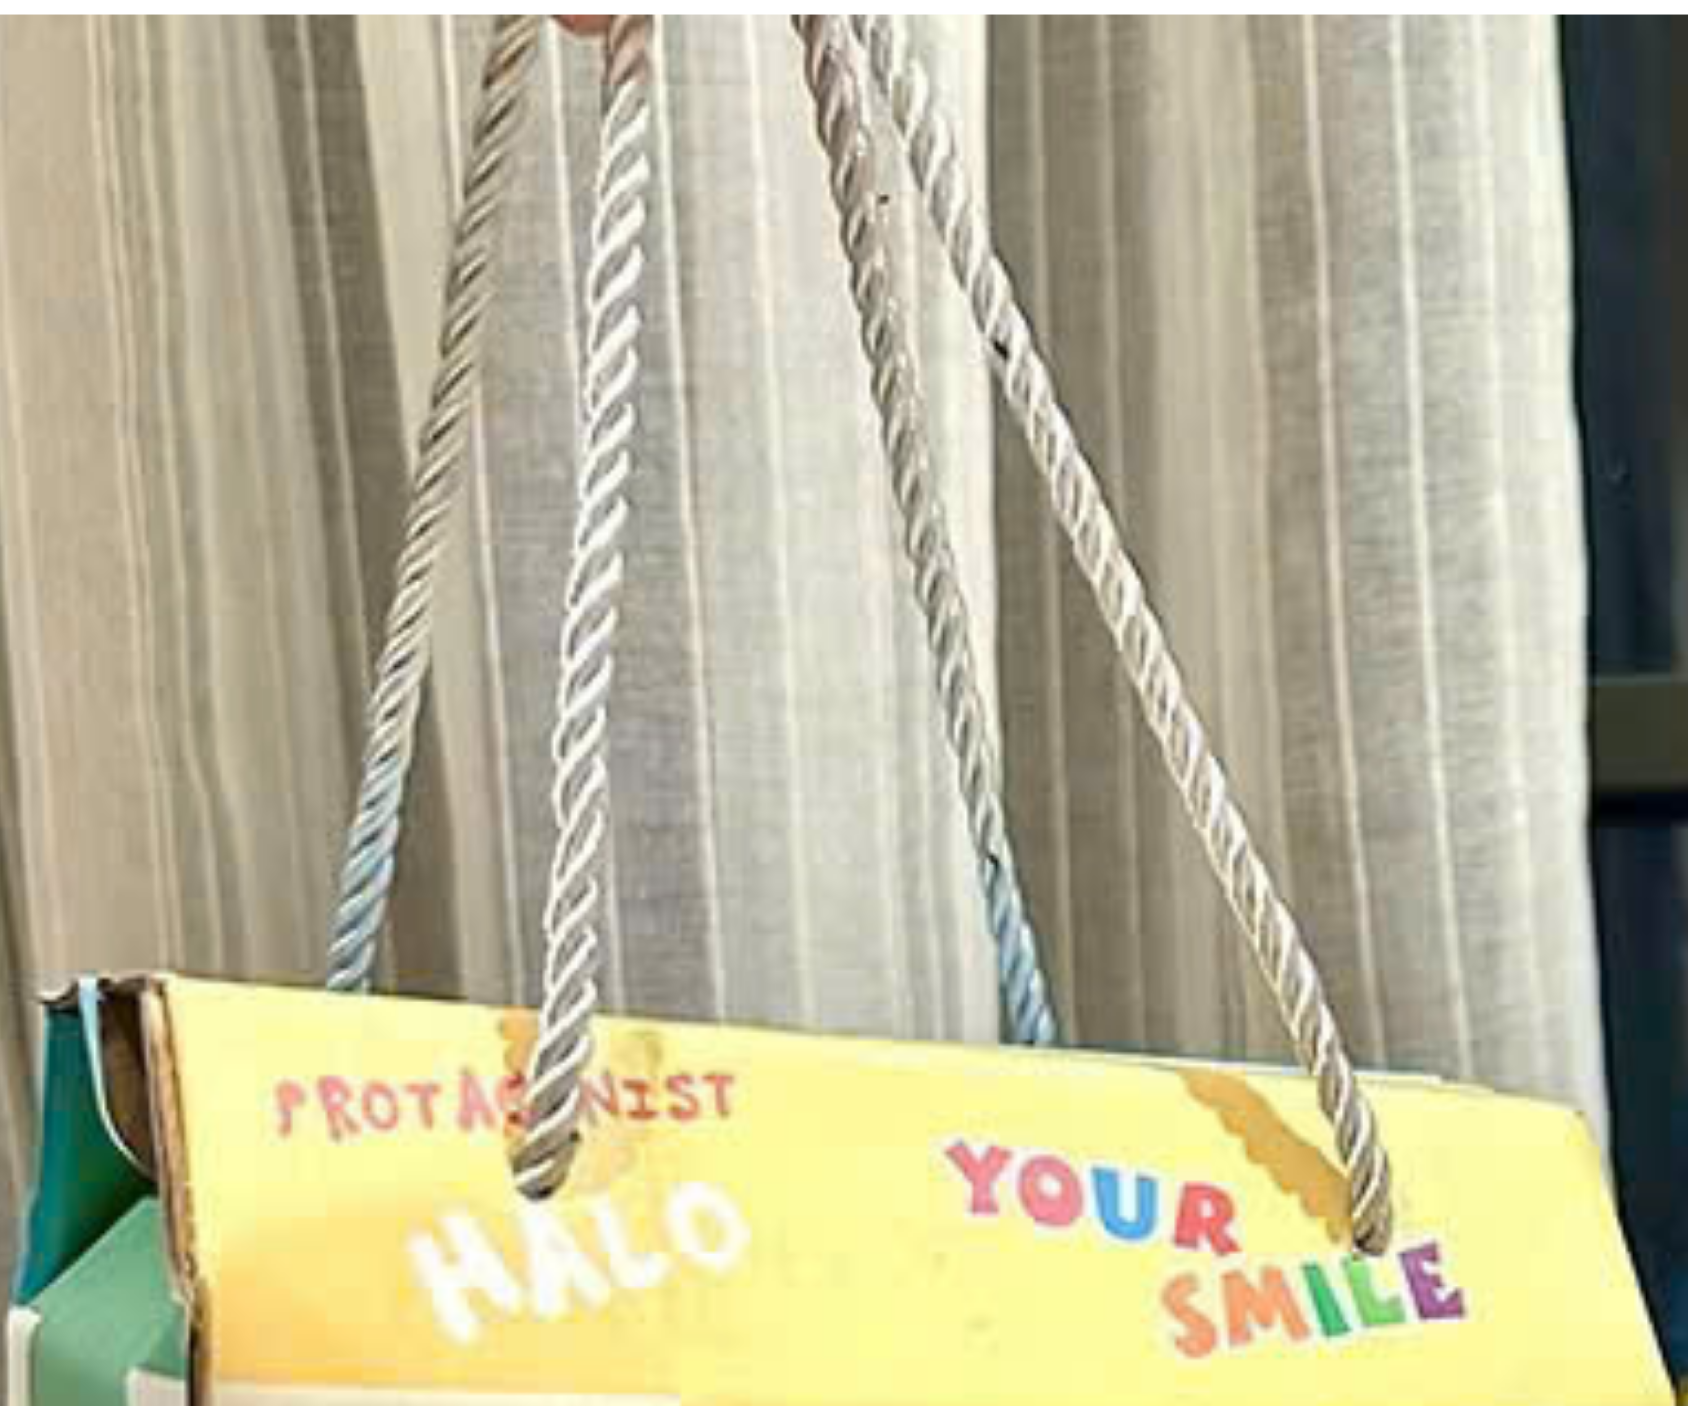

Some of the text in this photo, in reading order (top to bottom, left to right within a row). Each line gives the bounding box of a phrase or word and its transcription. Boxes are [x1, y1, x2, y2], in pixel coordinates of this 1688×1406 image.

[274, 1066, 735, 1141] PROTAGNIST
[944, 1138, 1242, 1257] YOUR
[405, 1180, 748, 1345] HALO
[1160, 1241, 1466, 1360] SMILE
